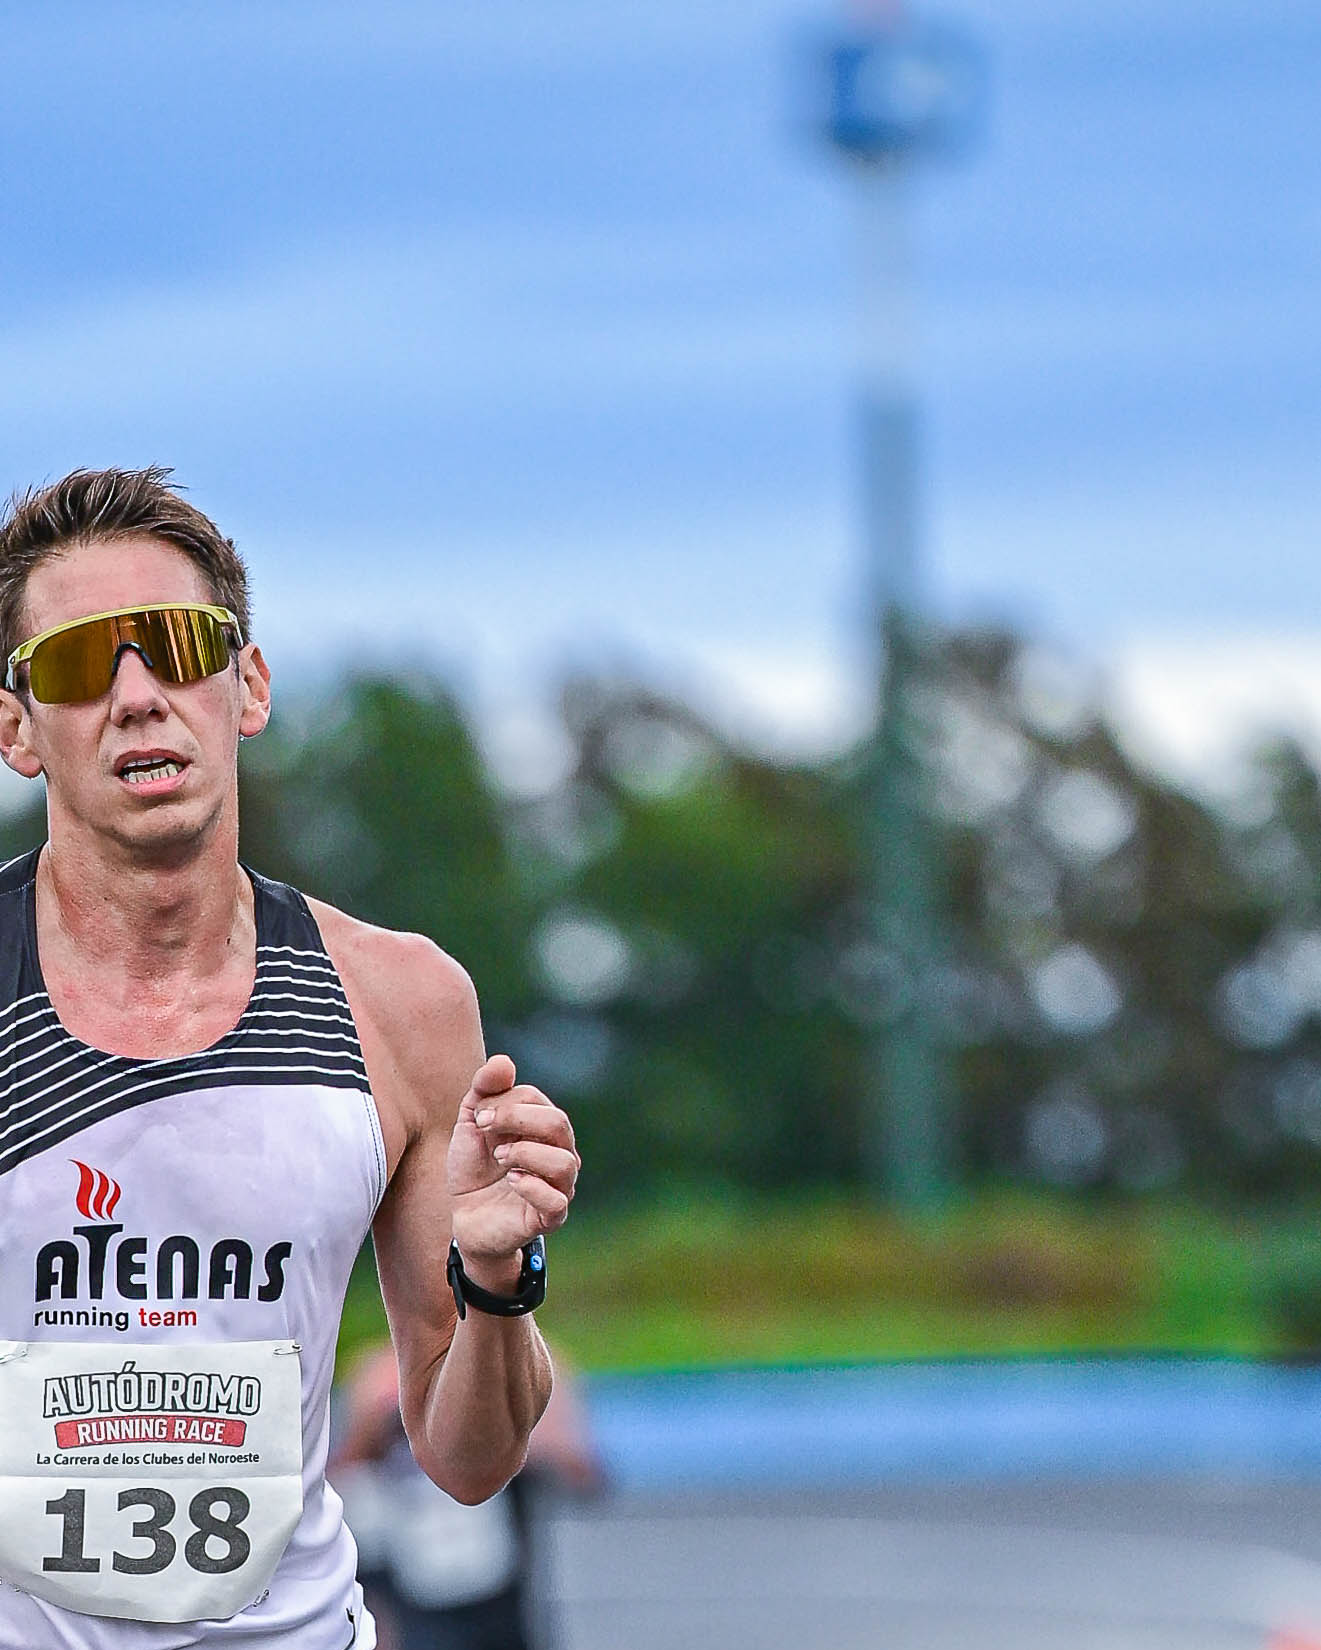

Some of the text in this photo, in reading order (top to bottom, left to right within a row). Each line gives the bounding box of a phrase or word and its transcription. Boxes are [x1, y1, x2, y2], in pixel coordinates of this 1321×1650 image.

[34, 1223, 293, 1303] ATENAS
[33, 1306, 197, 1331] running team
[43, 1361, 261, 1418] AUTÓDROMO
[76, 1418, 226, 1445] RUNNING RACE
[36, 1452, 260, 1465] La Carrera de los Clubes del Noroeste
[42, 1486, 251, 1575] 138
